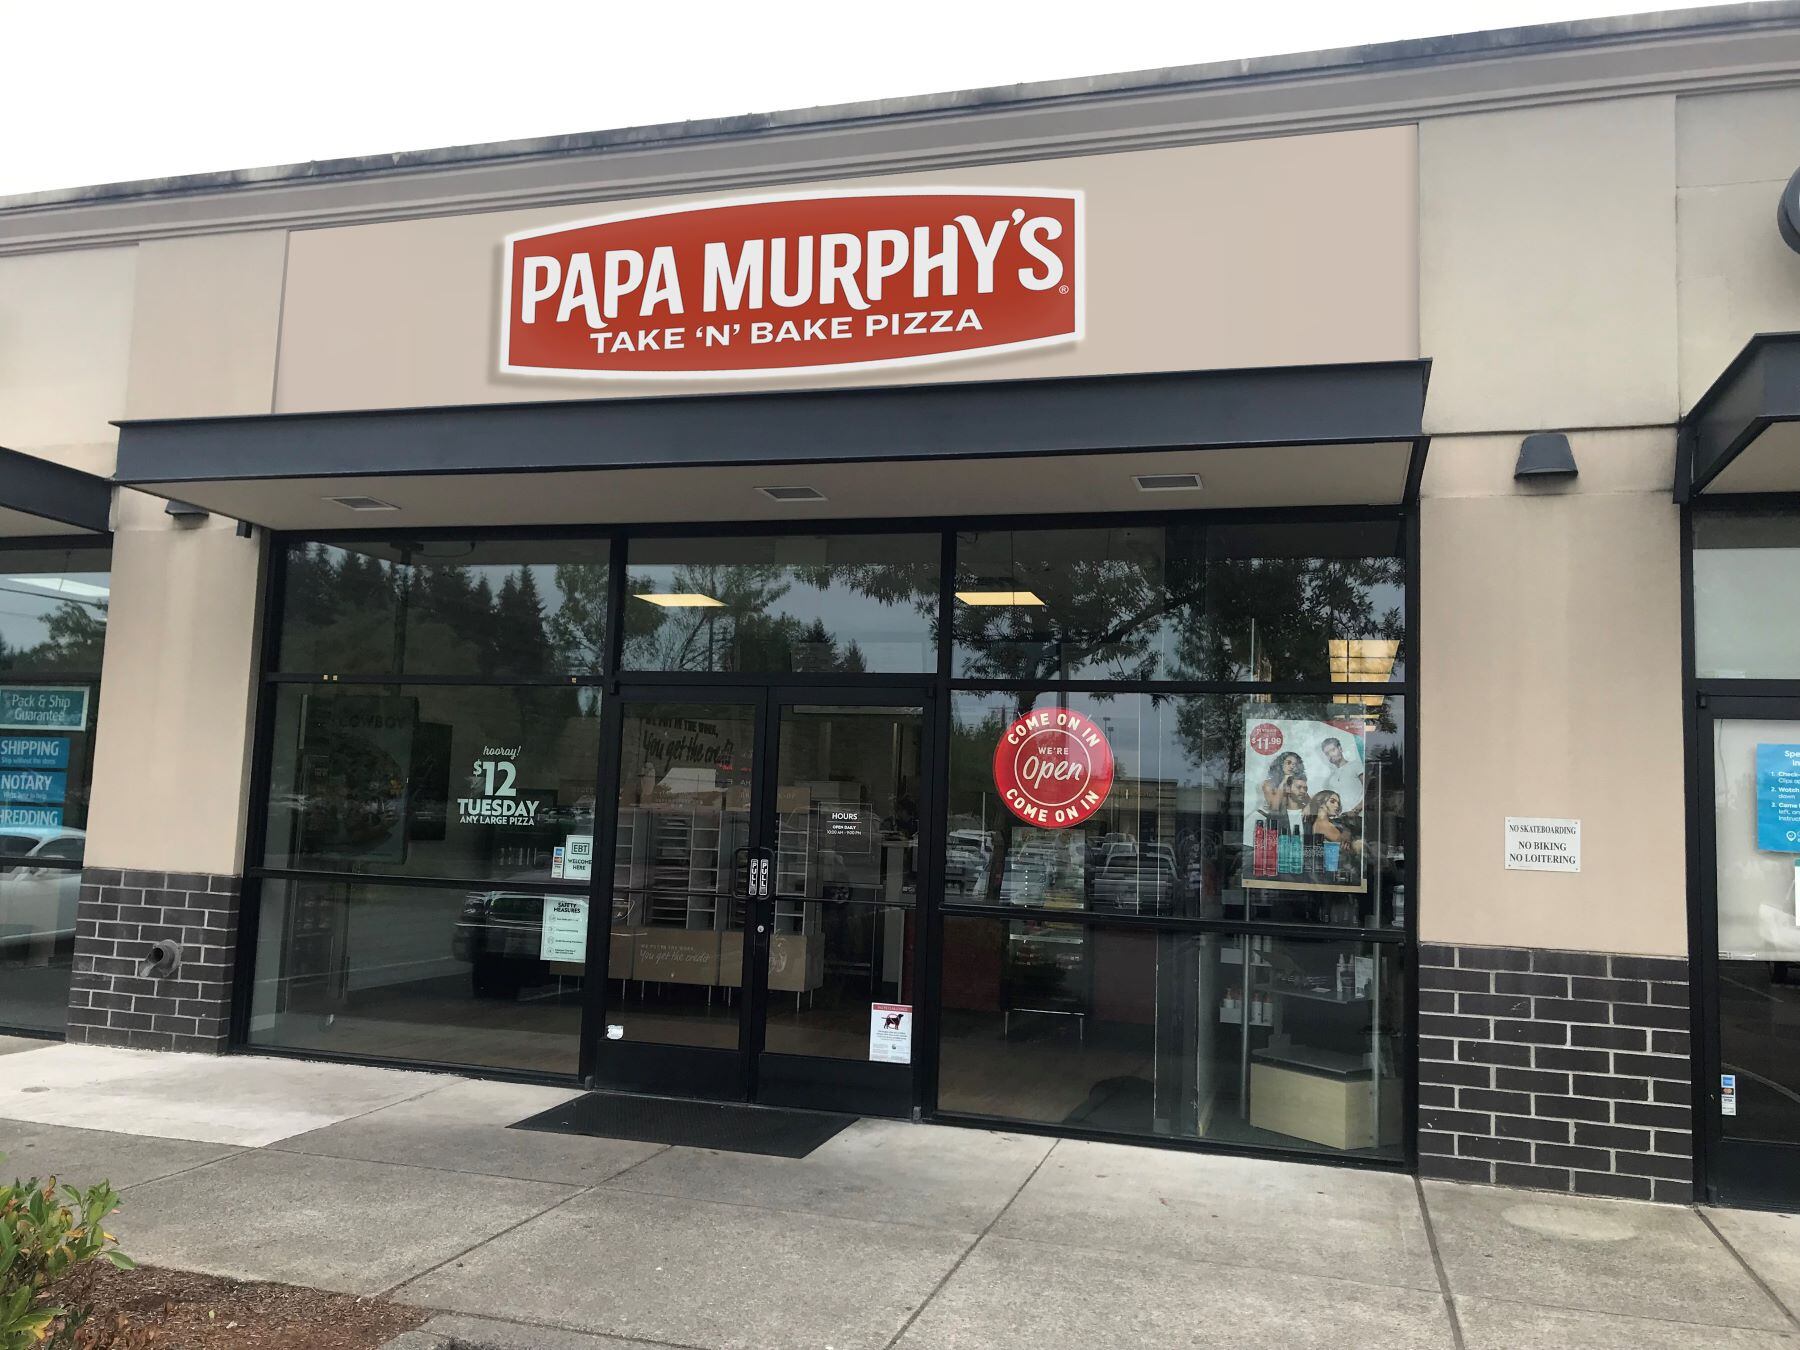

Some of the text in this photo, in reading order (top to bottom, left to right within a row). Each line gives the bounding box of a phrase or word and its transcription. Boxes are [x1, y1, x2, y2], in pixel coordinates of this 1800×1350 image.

[521, 207, 1064, 329] PAPA MURPHY'S
[590, 307, 984, 355] TAKE 'N' BAKE PIZZA
[11, 694, 71, 711] Pack & Ship
[14, 707, 65, 722] Guarantee
[1007, 712, 1102, 748] COME ON IN
[0, 739, 60, 757] SHIPPING
[1038, 747, 1070, 756] WE'RE
[1251, 737, 1282, 750] $11.99
[483, 745, 522, 760] hooray!
[473, 758, 517, 797] $12
[1022, 755, 1084, 790] Open
[1, 774, 53, 791] NOTARY
[457, 798, 540, 817] TUESDAY
[1006, 788, 1100, 823] COME ON IN
[459, 815, 535, 826] ANY LARGE PIZZA
[831, 812, 858, 820] HOURS
[1509, 824, 1576, 835] NO SKATEBOARDING
[573, 843, 589, 853] EBT
[1518, 841, 1567, 851] NO BIKING
[1509, 853, 1576, 864] NO LOITERING
